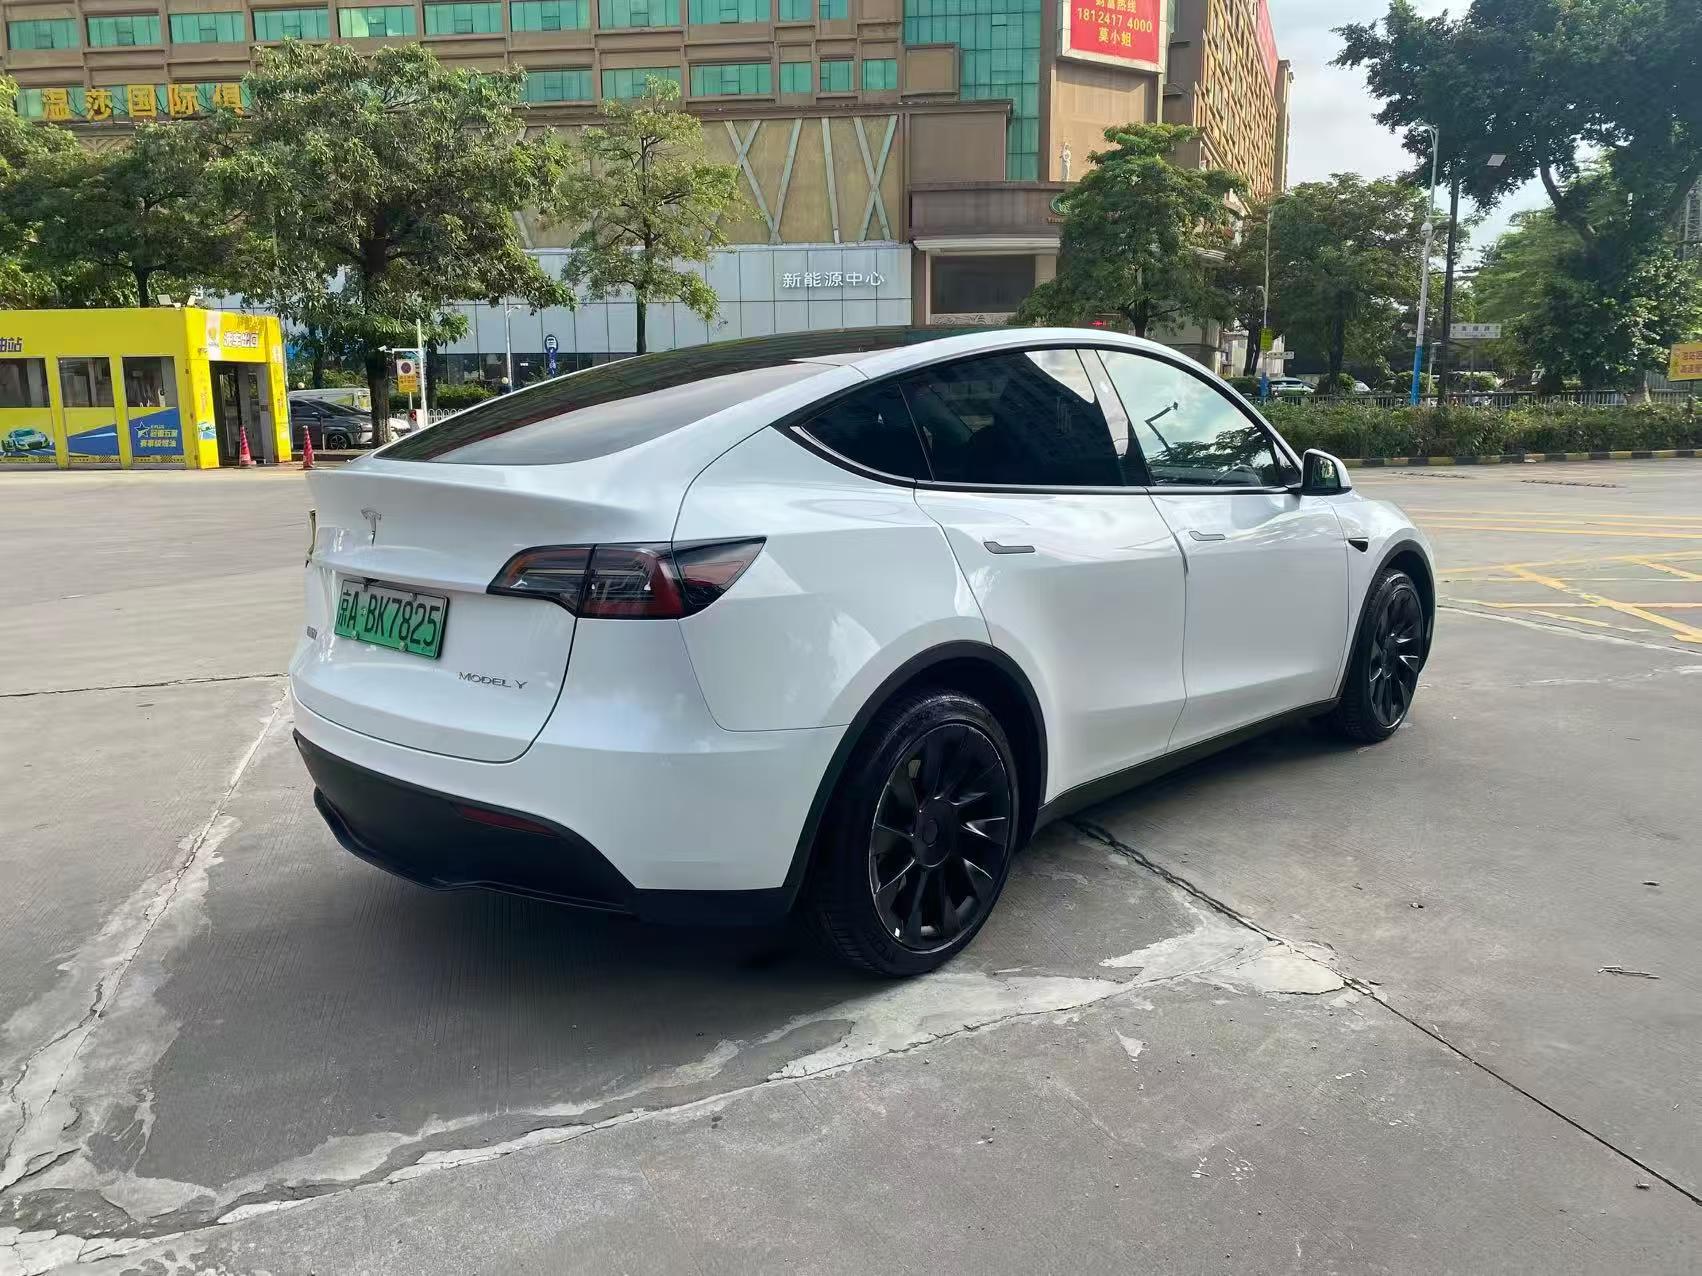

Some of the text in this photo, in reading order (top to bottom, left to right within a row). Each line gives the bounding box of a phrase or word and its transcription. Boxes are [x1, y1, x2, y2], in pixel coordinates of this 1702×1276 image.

[1098, 27, 1132, 47] 莫小姐
[782, 271, 885, 288] 新能源中心
[458, 671, 529, 690] MODEL Y
